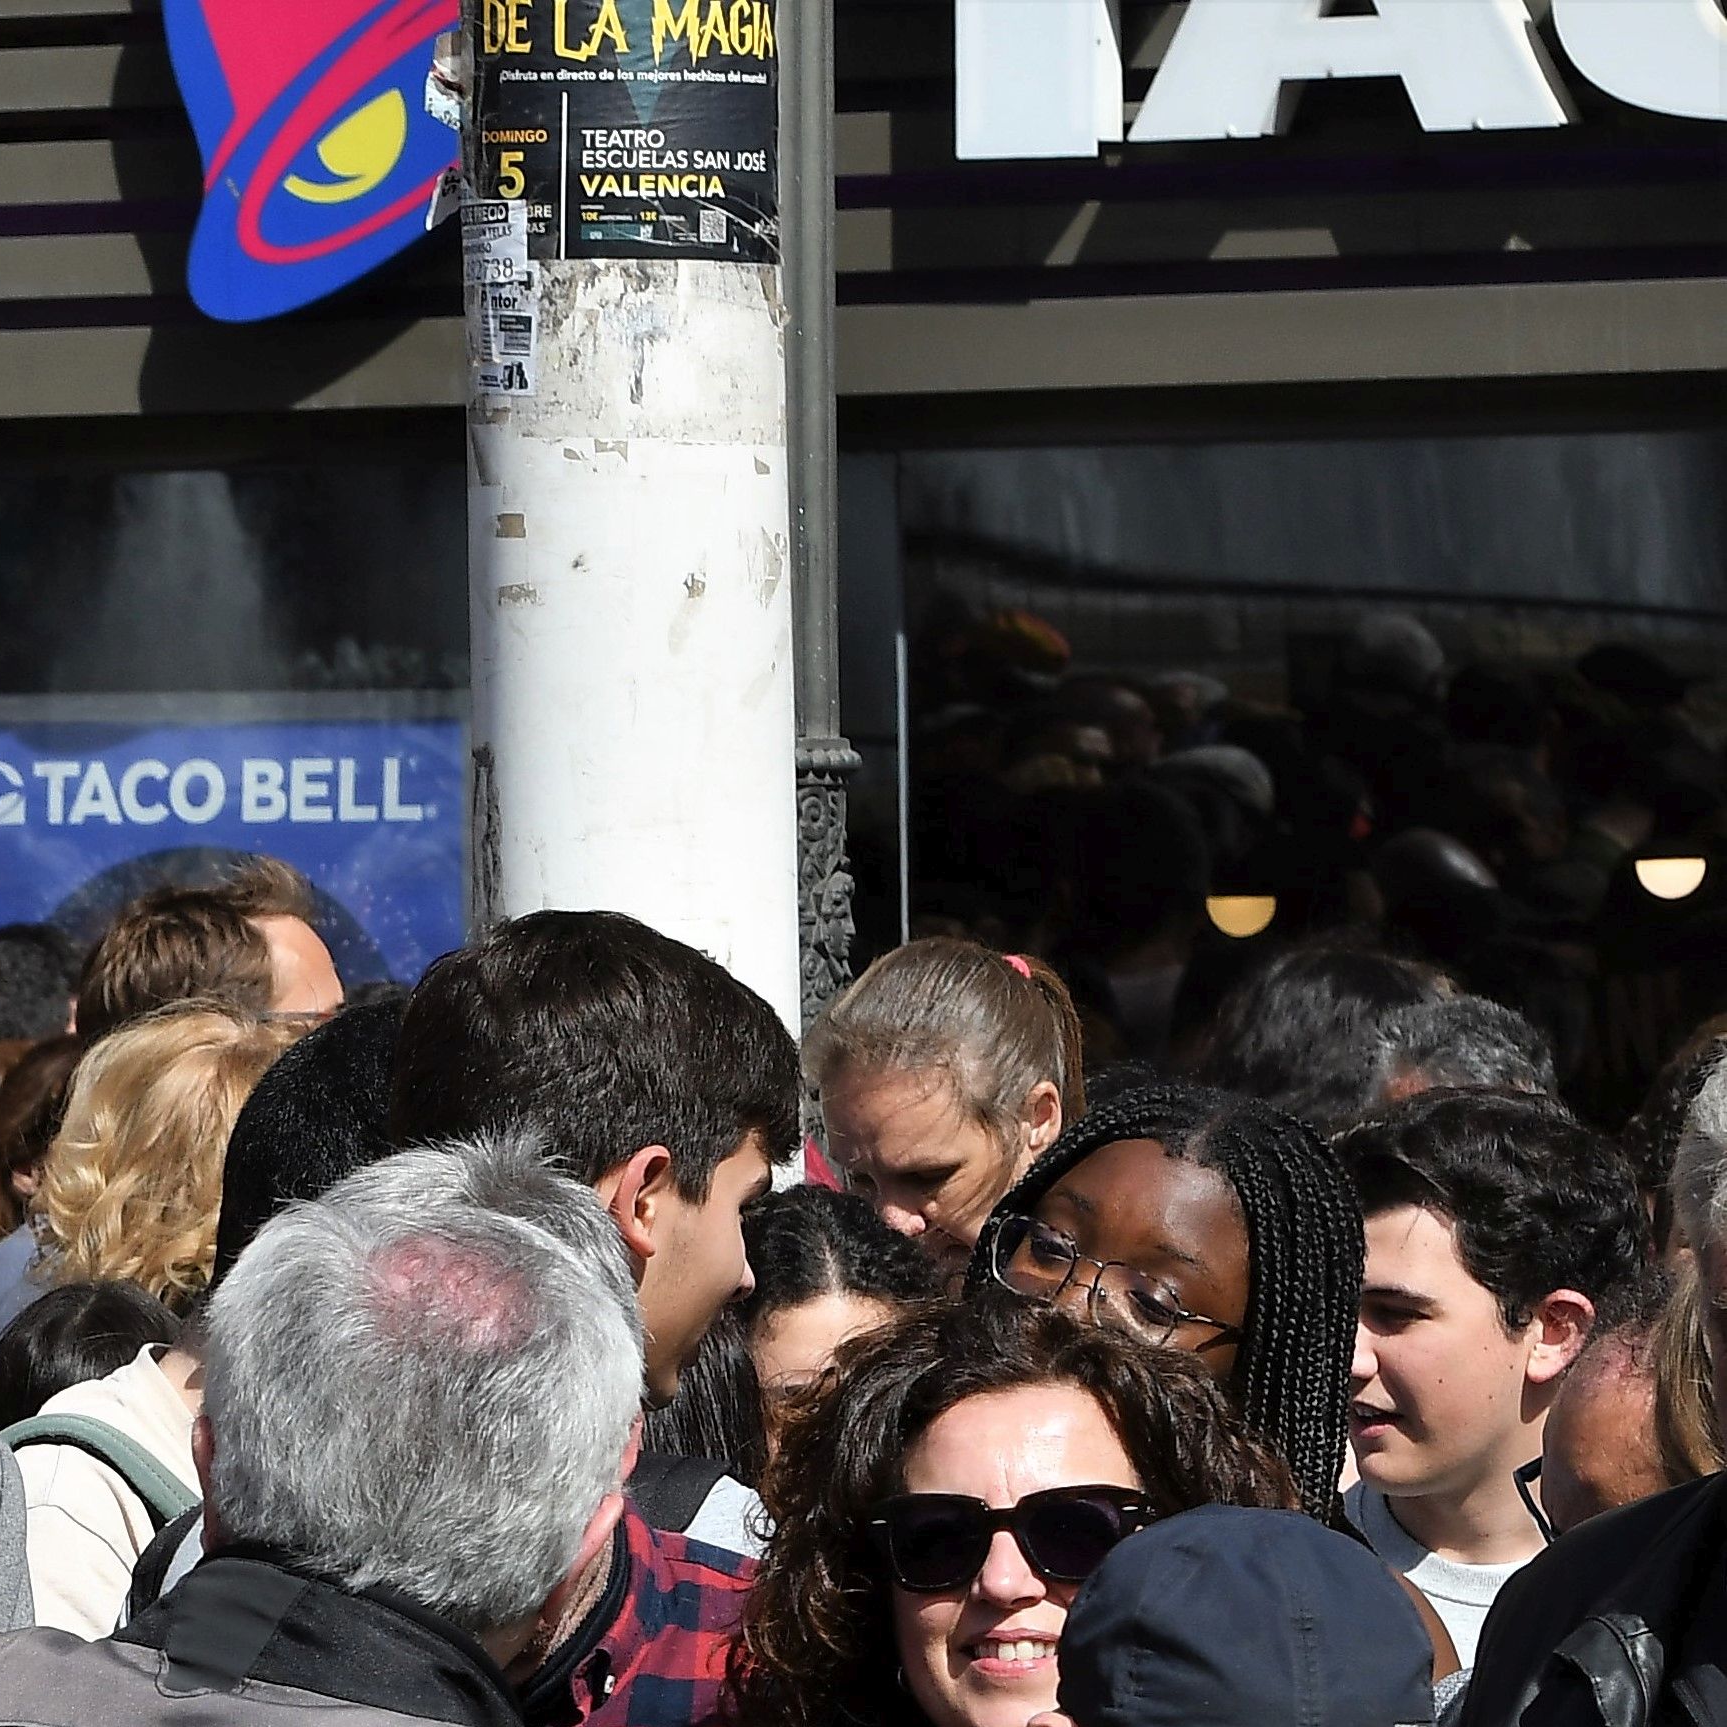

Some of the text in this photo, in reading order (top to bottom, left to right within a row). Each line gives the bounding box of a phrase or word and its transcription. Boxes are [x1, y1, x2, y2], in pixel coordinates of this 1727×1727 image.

[484, 0, 774, 67] DE LA MAGIA
[540, 71, 554, 81] en
[556, 69, 596, 81] directo
[598, 69, 614, 81] de
[617, 68, 634, 81] los
[636, 69, 681, 83] mejores
[683, 69, 726, 83] hechizos
[482, 130, 547, 144] DOMINGO
[581, 129, 665, 148] TEATRO
[581, 149, 767, 172] ESCUELAS SAN JOSÉ
[498, 151, 525, 199] 5
[580, 174, 725, 198] VALENCIA
[481, 291, 518, 309] Pntor
[34, 757, 423, 824] TACO BELL
